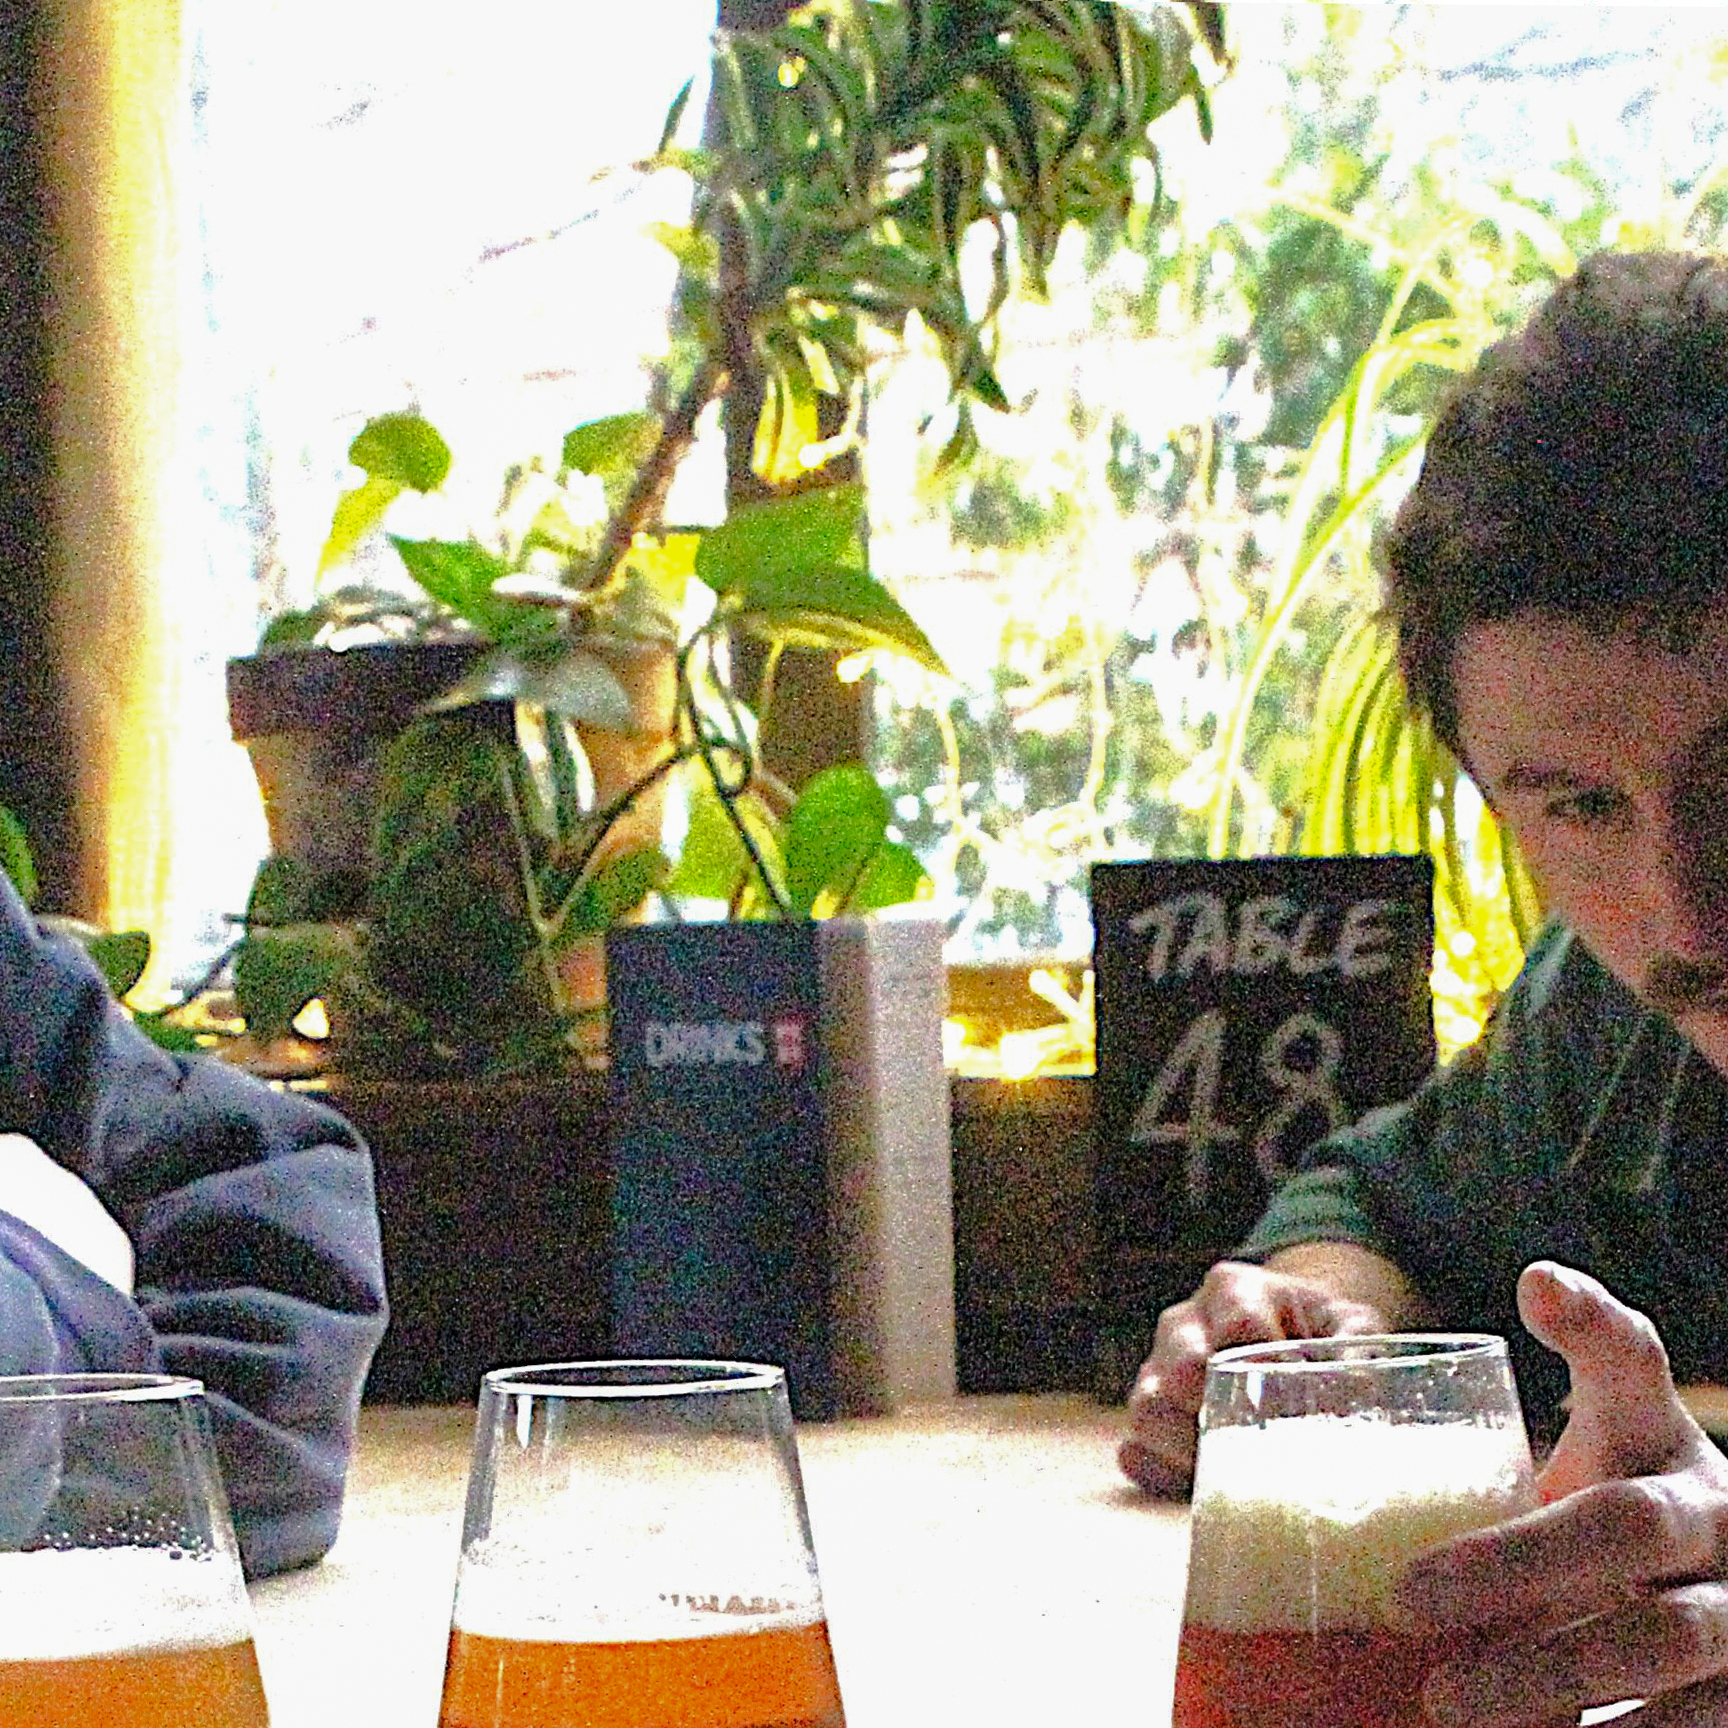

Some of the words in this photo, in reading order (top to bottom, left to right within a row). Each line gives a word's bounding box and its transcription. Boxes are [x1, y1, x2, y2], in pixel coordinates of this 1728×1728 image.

[1127, 891, 1402, 983] TABLE
[644, 1020, 766, 1067] DRINKS
[1127, 1007, 1351, 1204] 48
